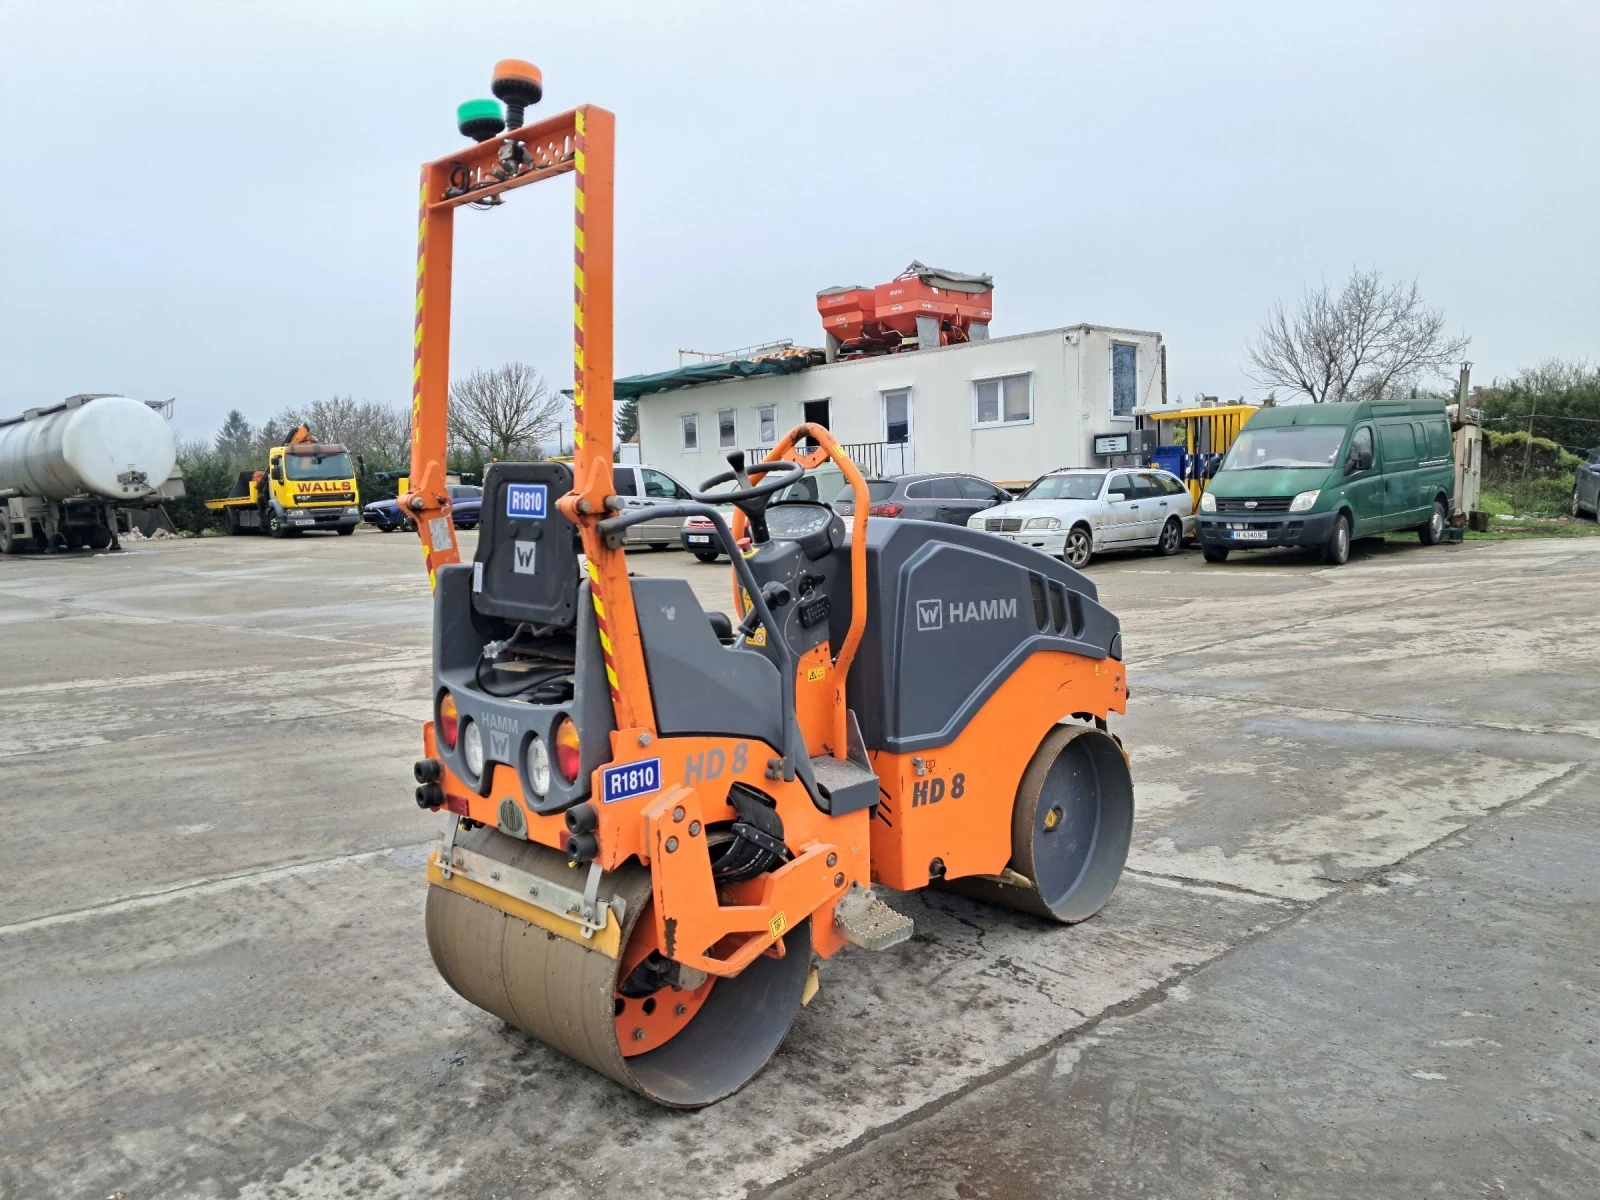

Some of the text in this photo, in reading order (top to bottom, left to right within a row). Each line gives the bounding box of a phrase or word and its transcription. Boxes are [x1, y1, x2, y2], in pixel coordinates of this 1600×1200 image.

[297, 481, 351, 493] WALLS
[511, 490, 542, 511] R1810
[949, 598, 1017, 623] HAMM
[481, 711, 519, 735] HAMM
[683, 742, 749, 787] HD 8
[611, 766, 654, 795] R1810
[912, 772, 966, 808] HD 8
